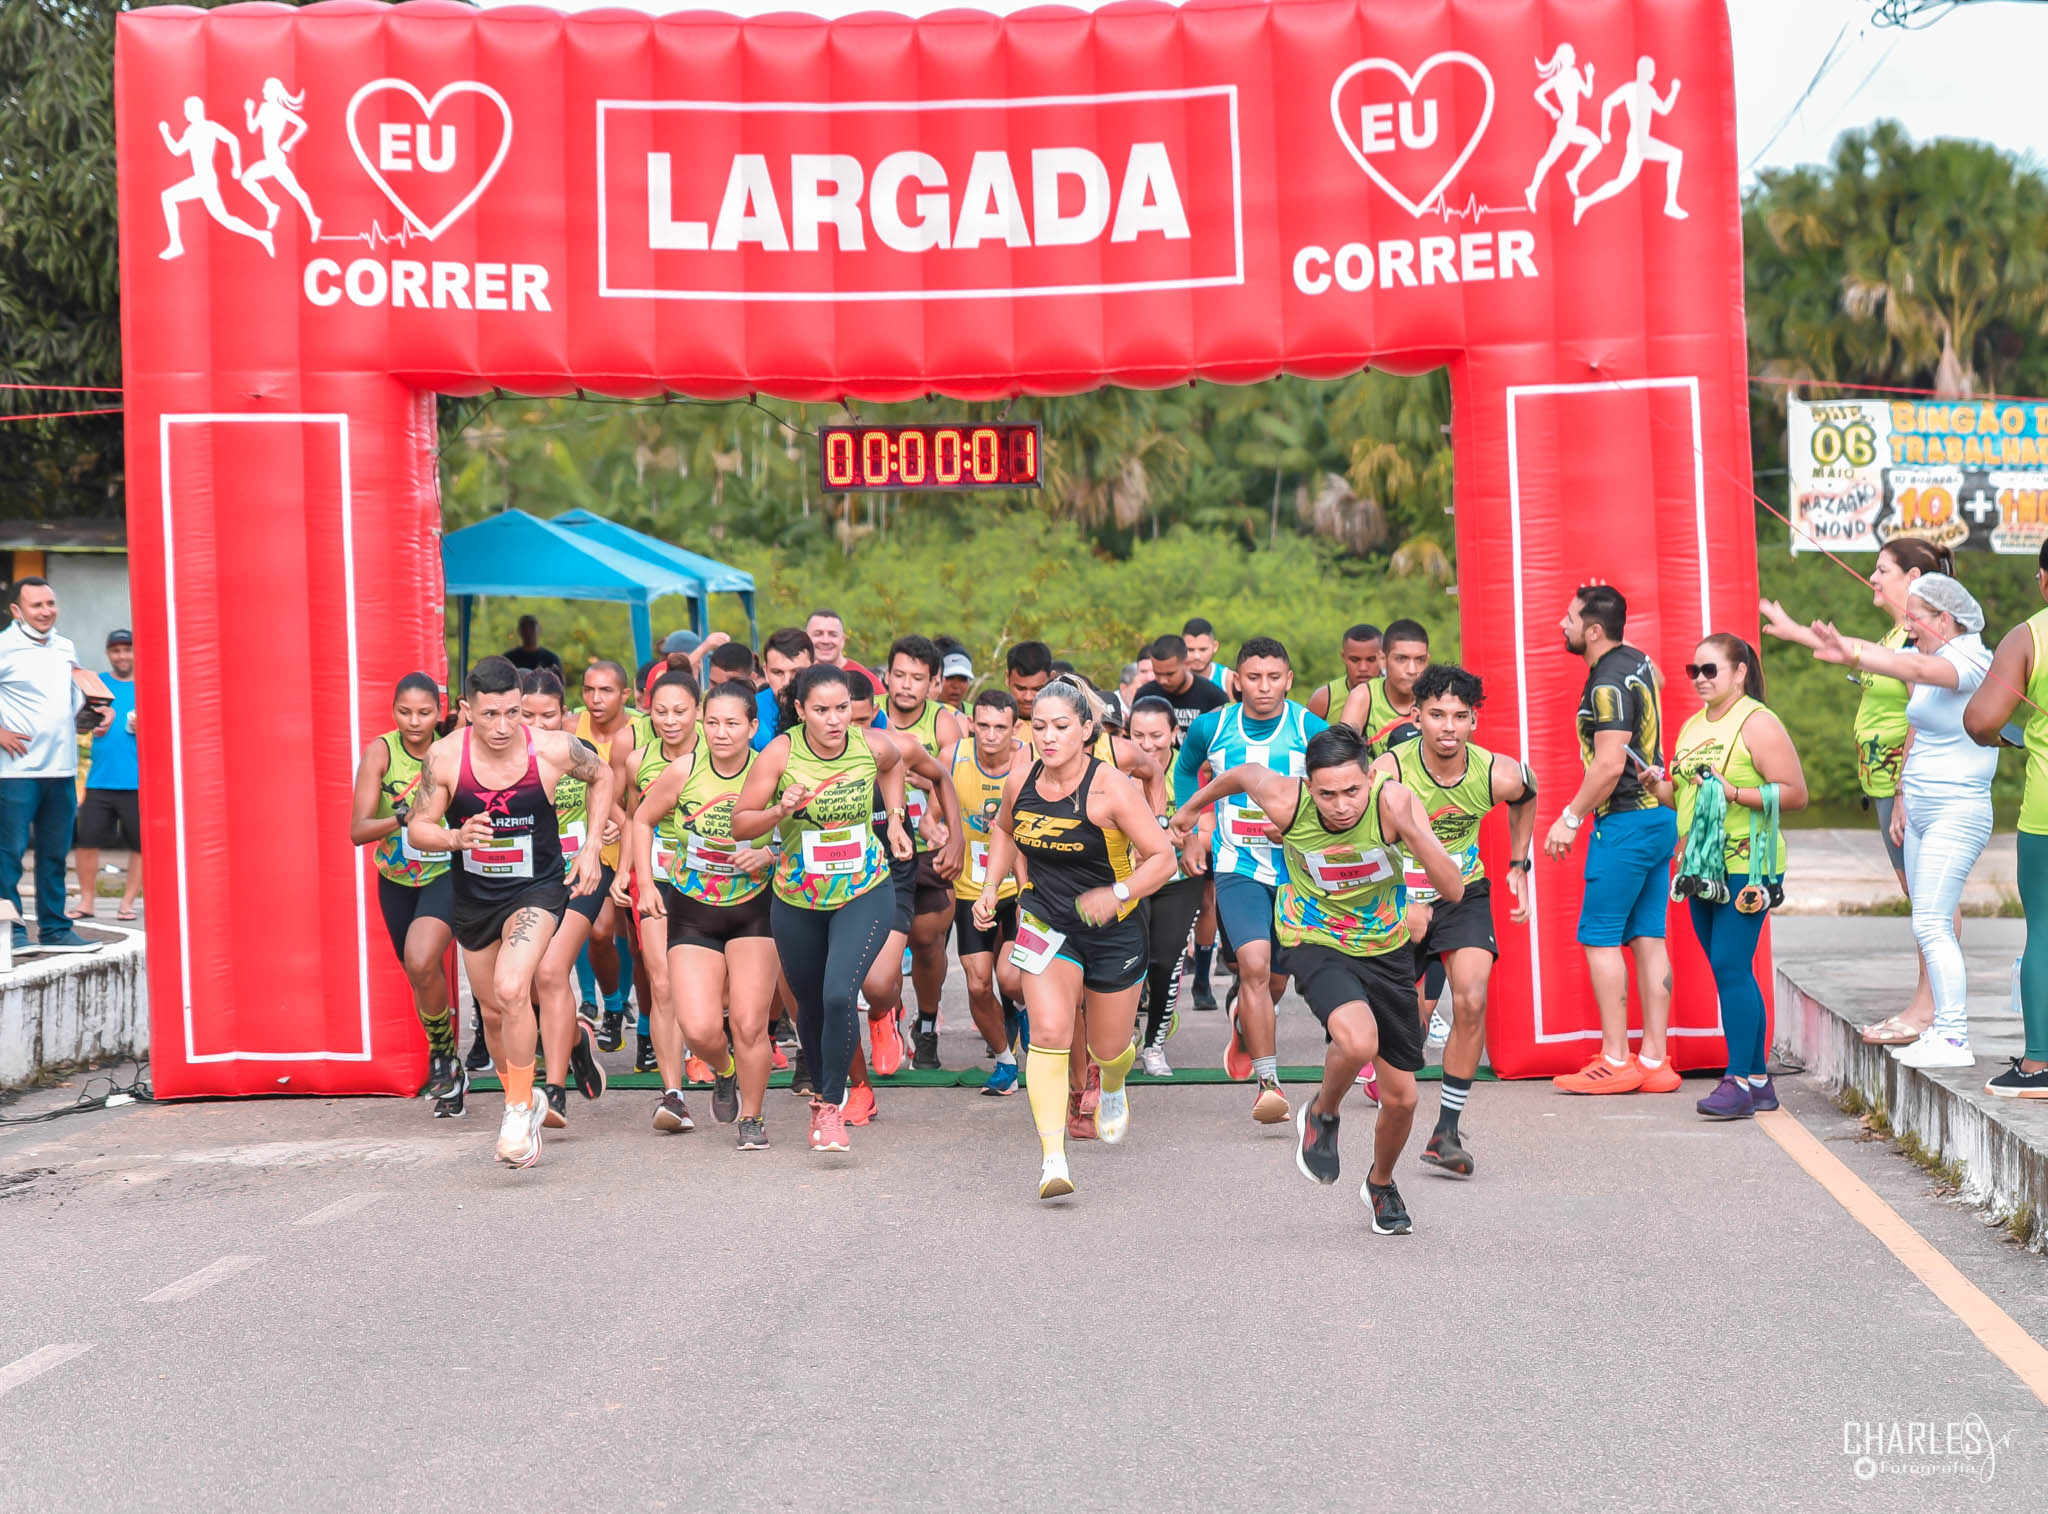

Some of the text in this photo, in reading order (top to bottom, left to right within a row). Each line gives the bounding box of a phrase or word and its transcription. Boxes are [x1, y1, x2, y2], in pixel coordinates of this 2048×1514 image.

[379, 123, 457, 173] EU
[1361, 99, 1438, 154] EU
[647, 142, 1191, 252] LARGADA
[303, 258, 553, 312] CORRER
[1293, 229, 1539, 295] CORRER
[1891, 401, 2026, 435] BINGÃO
[1811, 423, 1877, 467] 06
[1815, 519, 1866, 538] NOVO
[1898, 486, 1954, 527] 10
